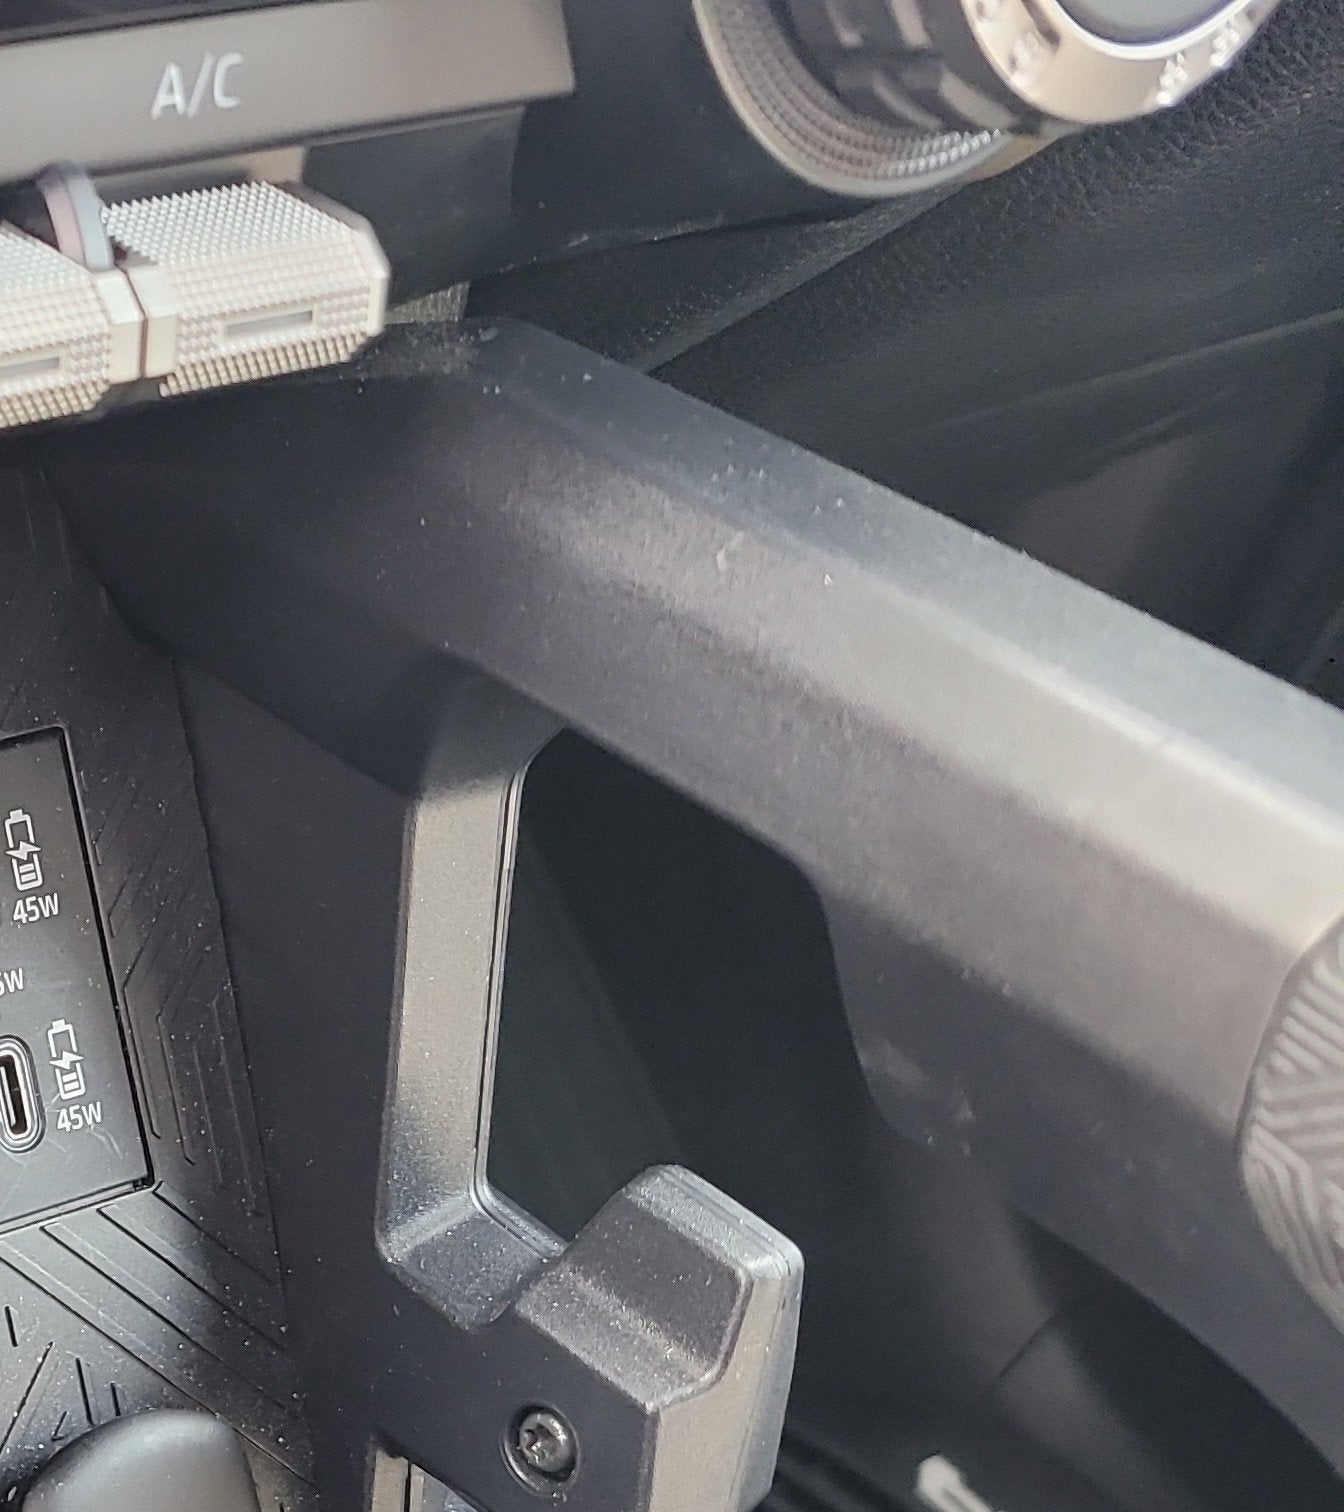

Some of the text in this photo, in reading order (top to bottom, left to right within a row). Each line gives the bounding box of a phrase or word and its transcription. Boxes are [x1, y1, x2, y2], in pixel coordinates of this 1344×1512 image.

[151, 51, 242, 120] A/C
[12, 893, 60, 924] 45W
[56, 1102, 103, 1132] 45W
